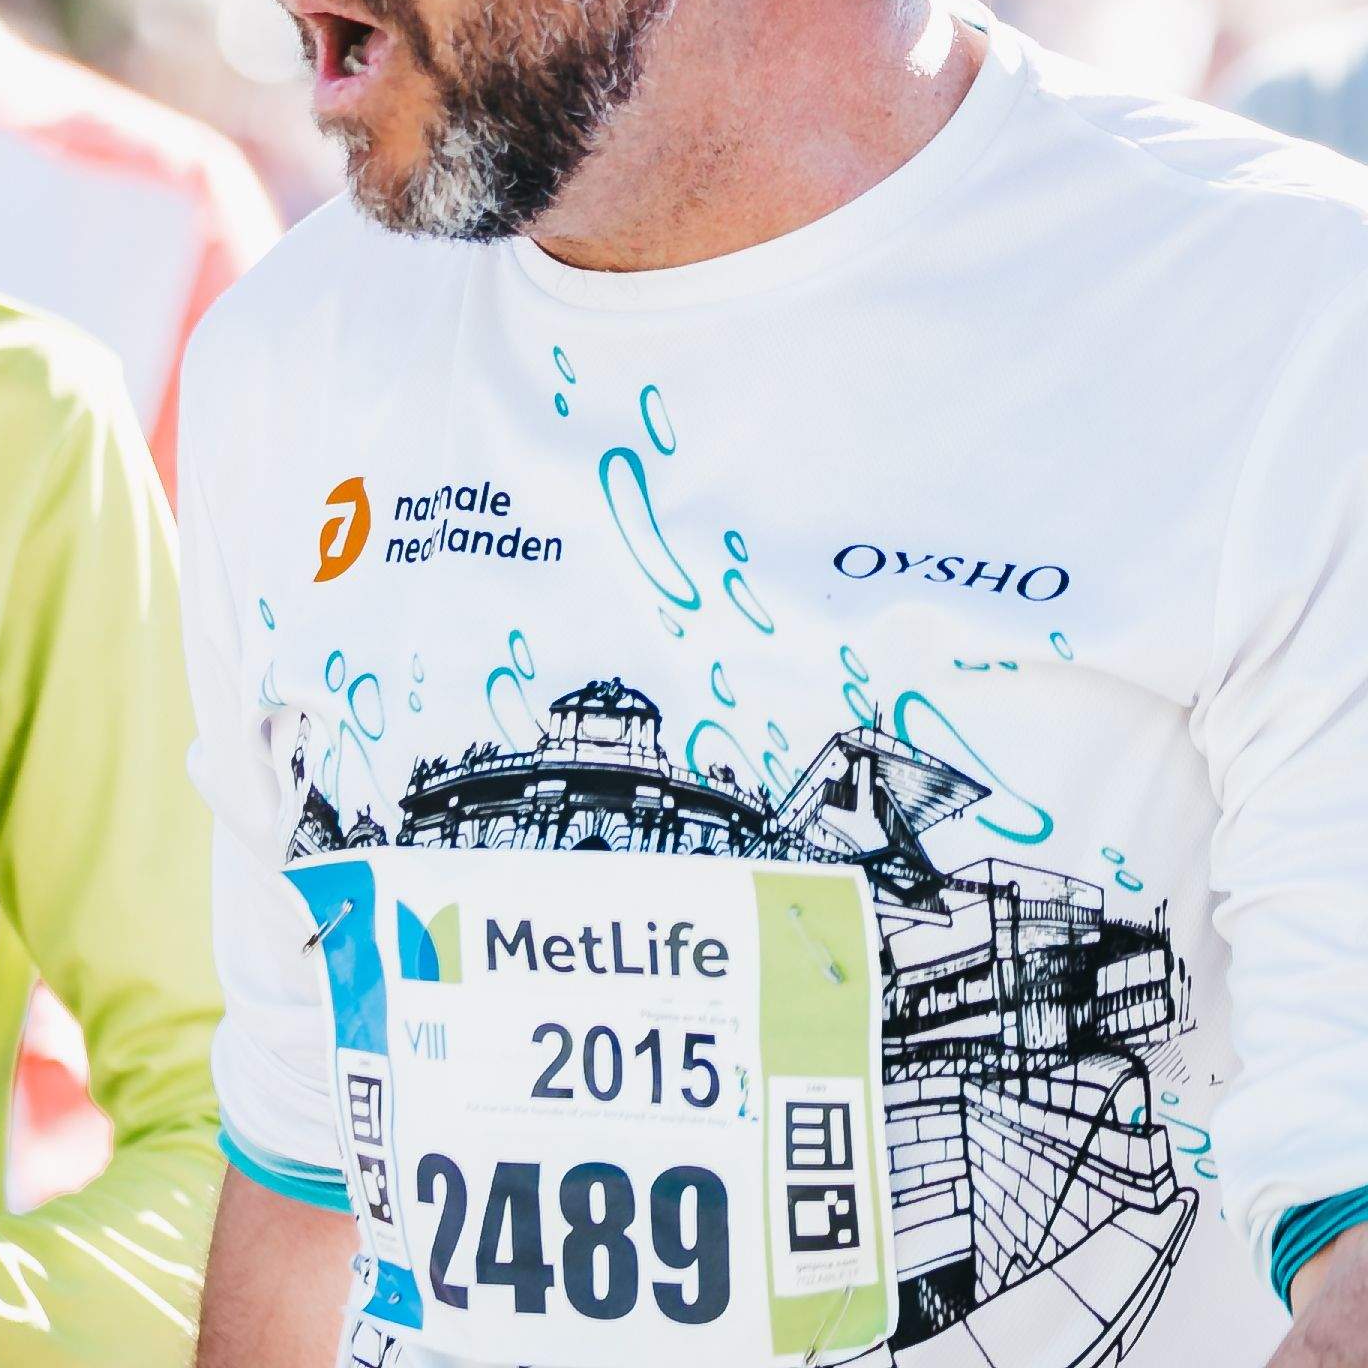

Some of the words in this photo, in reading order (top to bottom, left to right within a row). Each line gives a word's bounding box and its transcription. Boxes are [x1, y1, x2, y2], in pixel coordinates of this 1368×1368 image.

[832, 544, 1070, 602] OYSHO
[486, 918, 730, 978] MetLife
[404, 1020, 447, 1062] VIII
[530, 1022, 721, 1109] 2015
[416, 1151, 731, 1325] 2489
